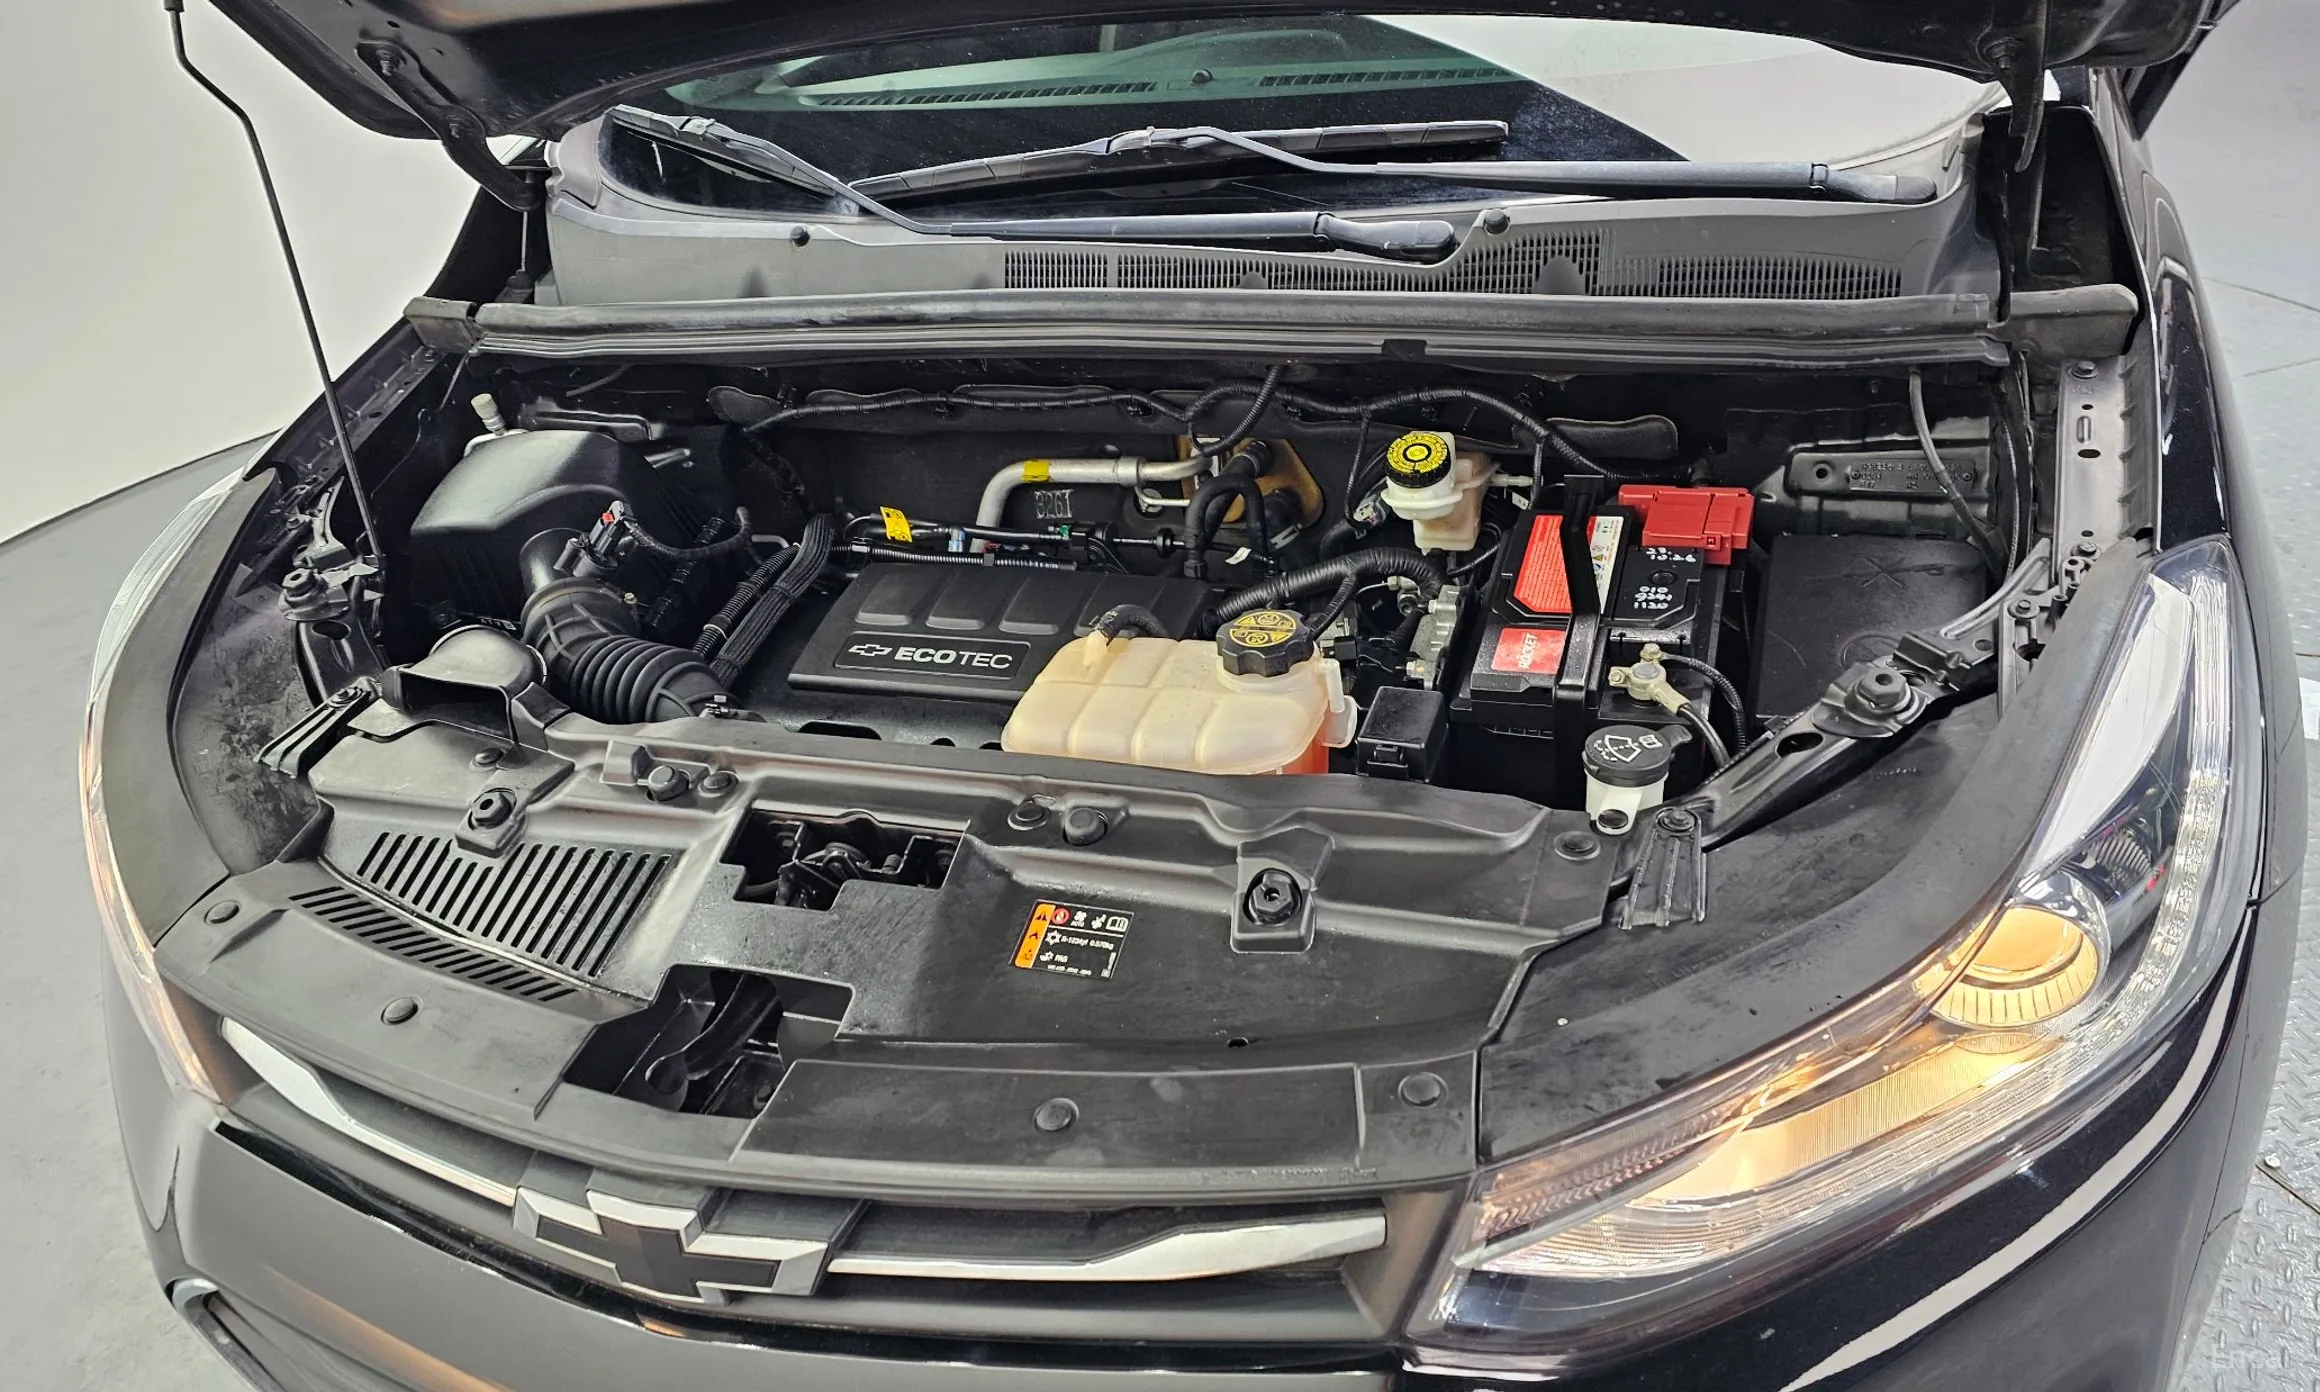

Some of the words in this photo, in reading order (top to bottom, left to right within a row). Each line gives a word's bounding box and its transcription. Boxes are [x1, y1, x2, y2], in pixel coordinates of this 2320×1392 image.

[1639, 585, 1669, 593] 010
[894, 646, 1013, 670] ECOTEC
[1518, 632, 1538, 669] ROCKET
